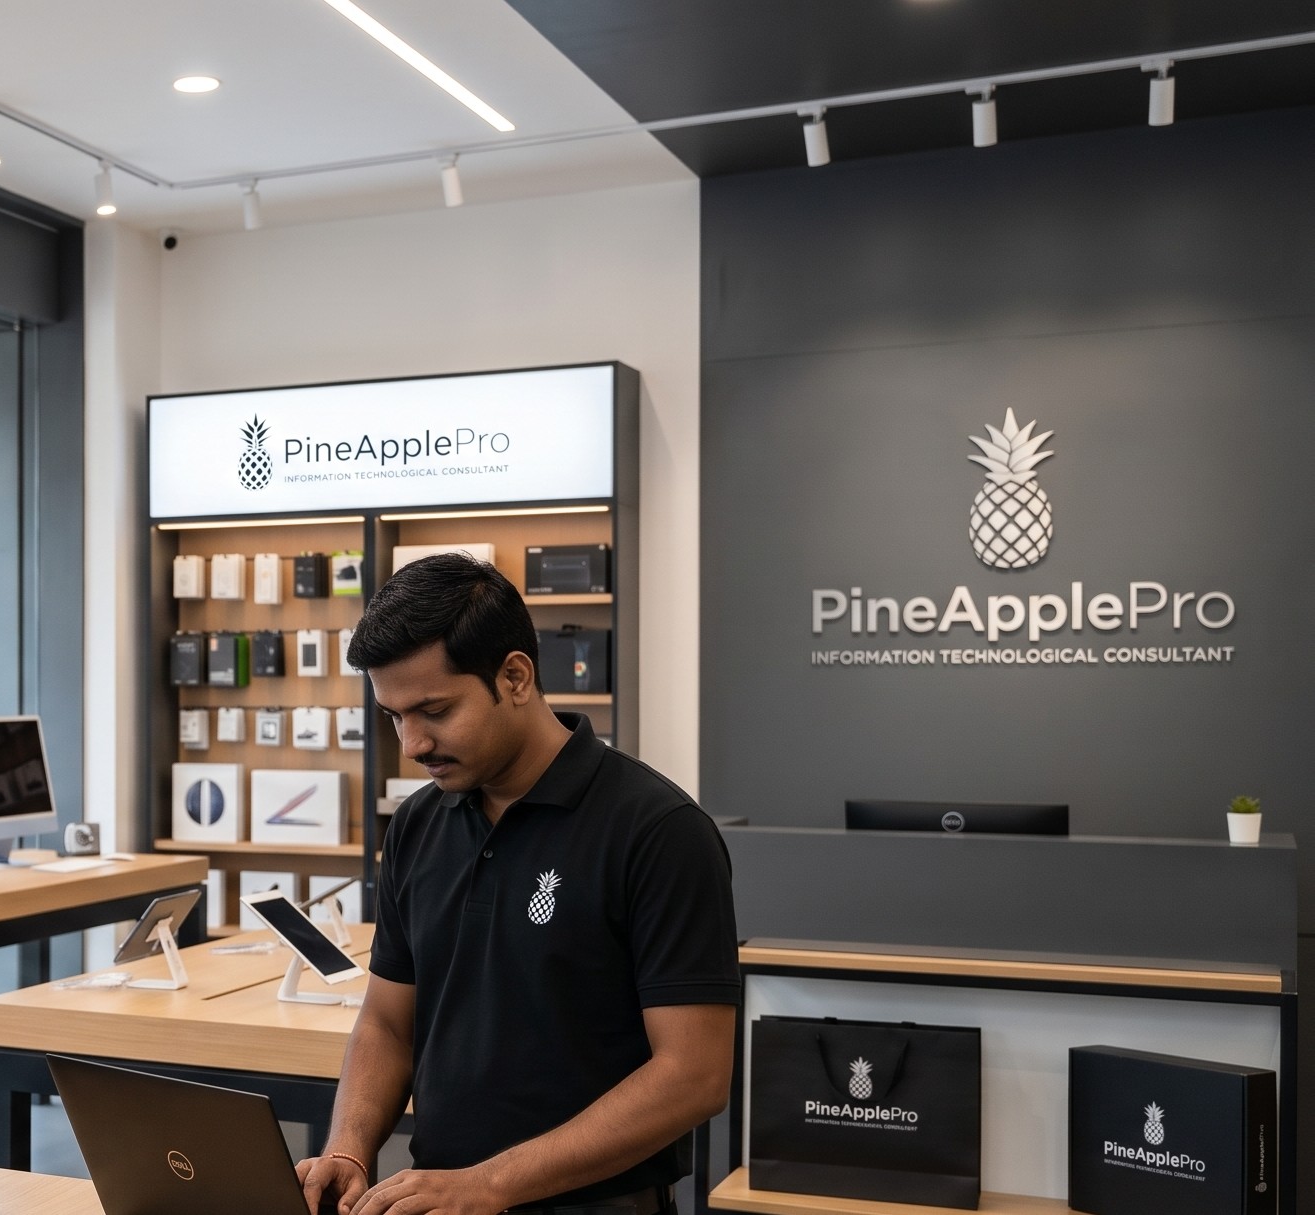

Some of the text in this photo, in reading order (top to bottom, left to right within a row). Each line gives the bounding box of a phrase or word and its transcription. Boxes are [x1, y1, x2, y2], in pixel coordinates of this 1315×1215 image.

[285, 428, 510, 466] PineApplePro
[284, 464, 509, 483] INFORMATION TECHNOLOGICAL CONSULTANT
[811, 581, 1236, 642] PineApplePro
[811, 646, 1235, 665] INFORMATION TECHNOLOGICAL CONSULTANT
[805, 1100, 918, 1123] PineApplePro
[1104, 1140, 1206, 1172] PineApplePro
